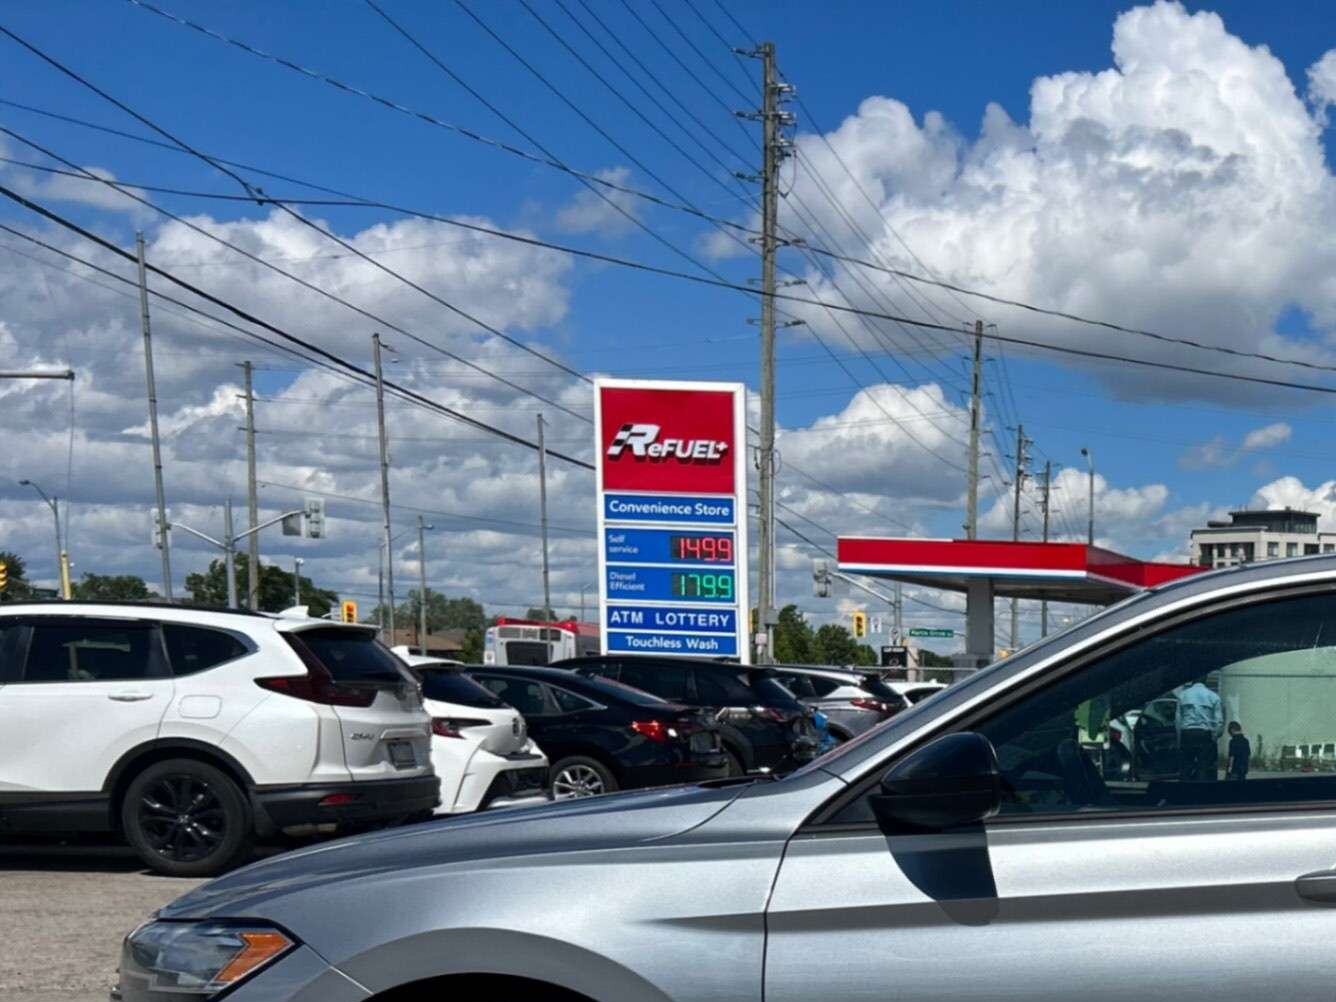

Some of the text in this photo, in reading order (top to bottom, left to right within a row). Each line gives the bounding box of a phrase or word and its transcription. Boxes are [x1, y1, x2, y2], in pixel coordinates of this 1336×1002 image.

[609, 500, 730, 516] Convenience Store
[611, 611, 729, 627] ATM LOTTERY
[626, 636, 718, 650] Touchless Wash
